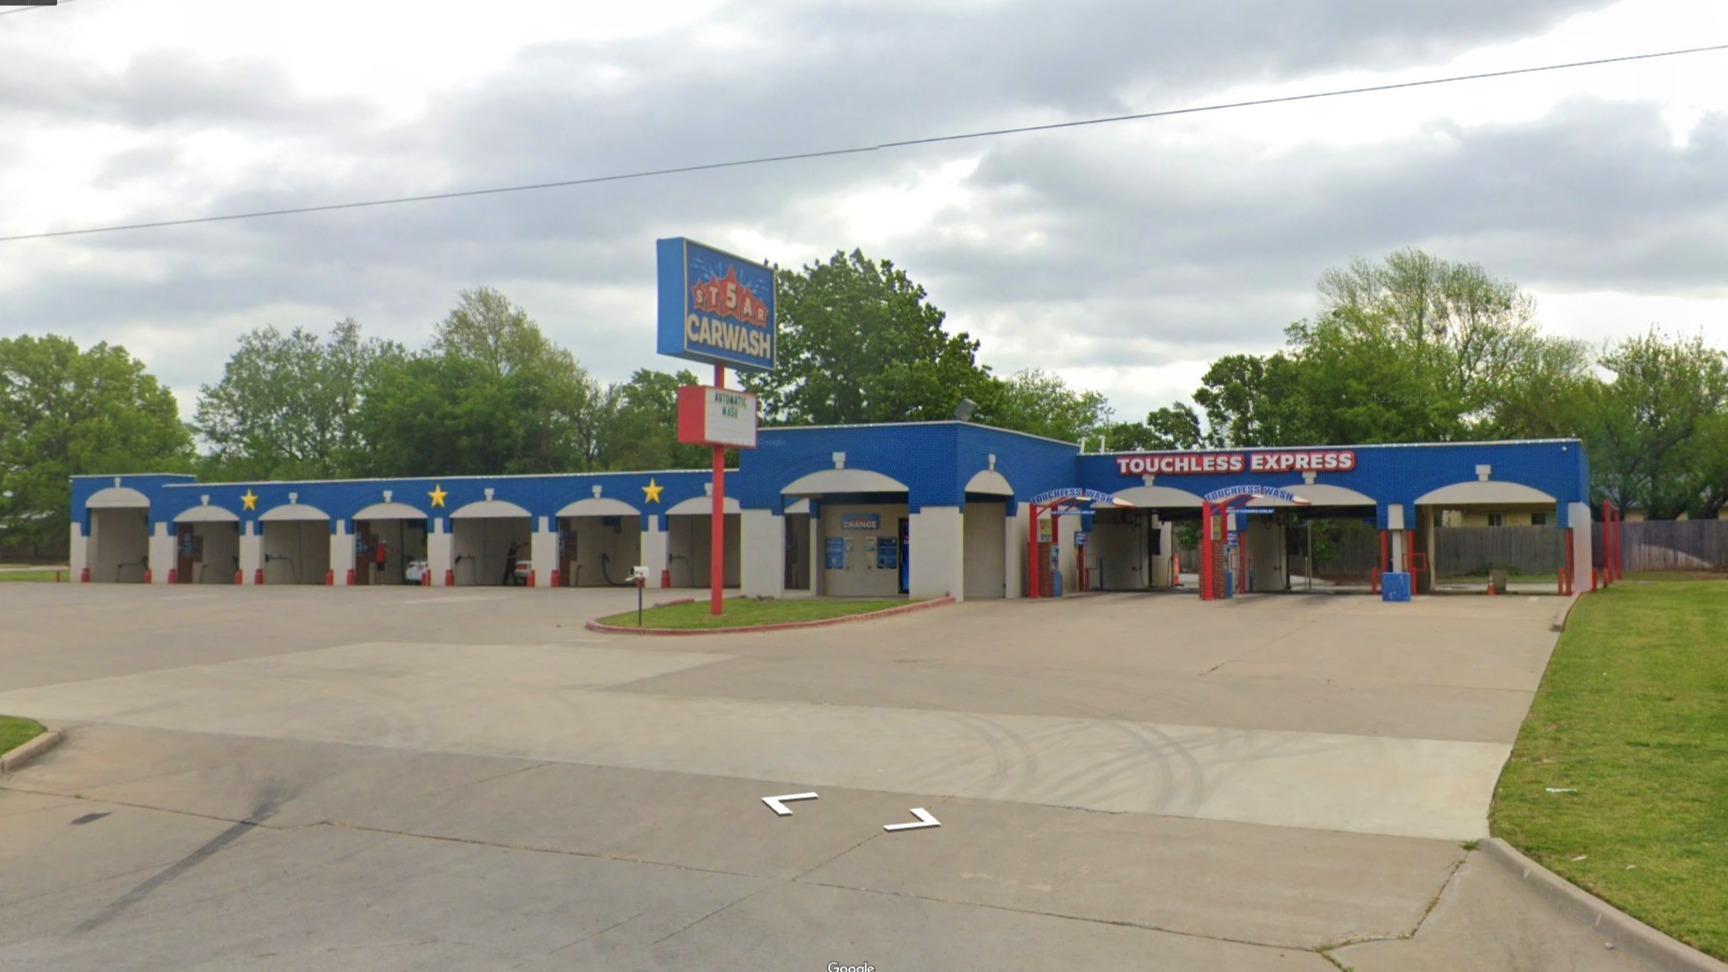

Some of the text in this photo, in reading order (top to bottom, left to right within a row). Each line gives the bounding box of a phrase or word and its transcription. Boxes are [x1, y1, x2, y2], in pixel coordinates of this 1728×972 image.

[687, 314, 771, 359] CARWASH
[1117, 453, 1353, 473] TOUCHLESS EXPRESS
[1204, 485, 1295, 502] TOUCHLESS WASH
